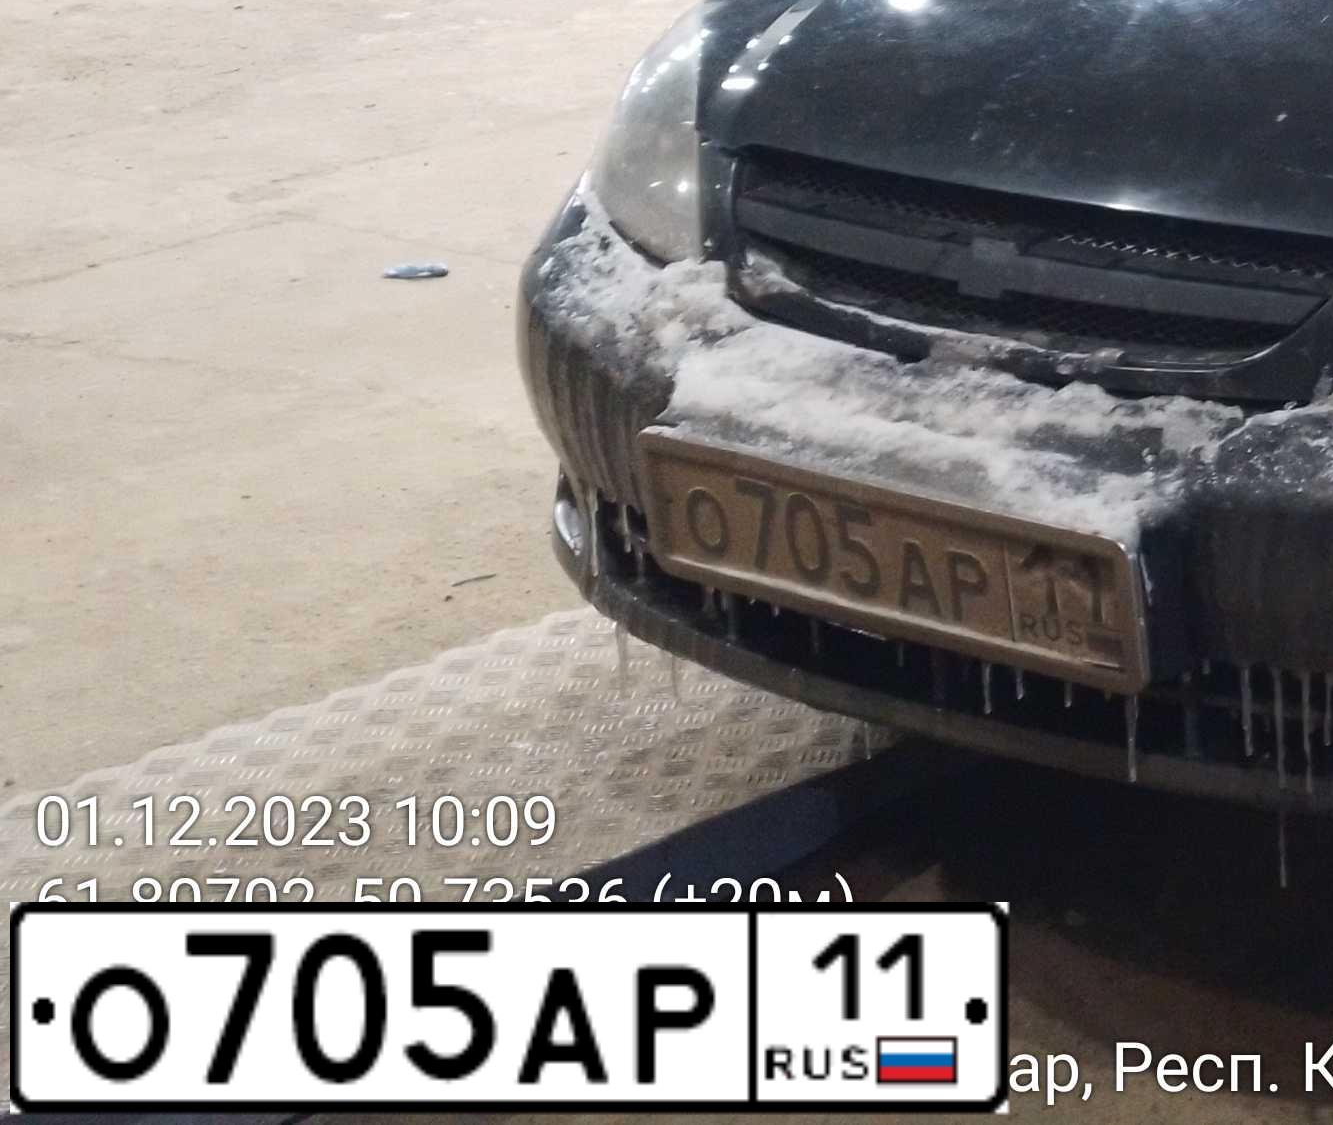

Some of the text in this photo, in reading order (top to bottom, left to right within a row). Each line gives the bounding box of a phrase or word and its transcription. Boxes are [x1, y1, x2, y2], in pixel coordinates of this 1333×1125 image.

[685, 475, 1116, 624] О705АР 11
[1018, 613, 1083, 646] RUS
